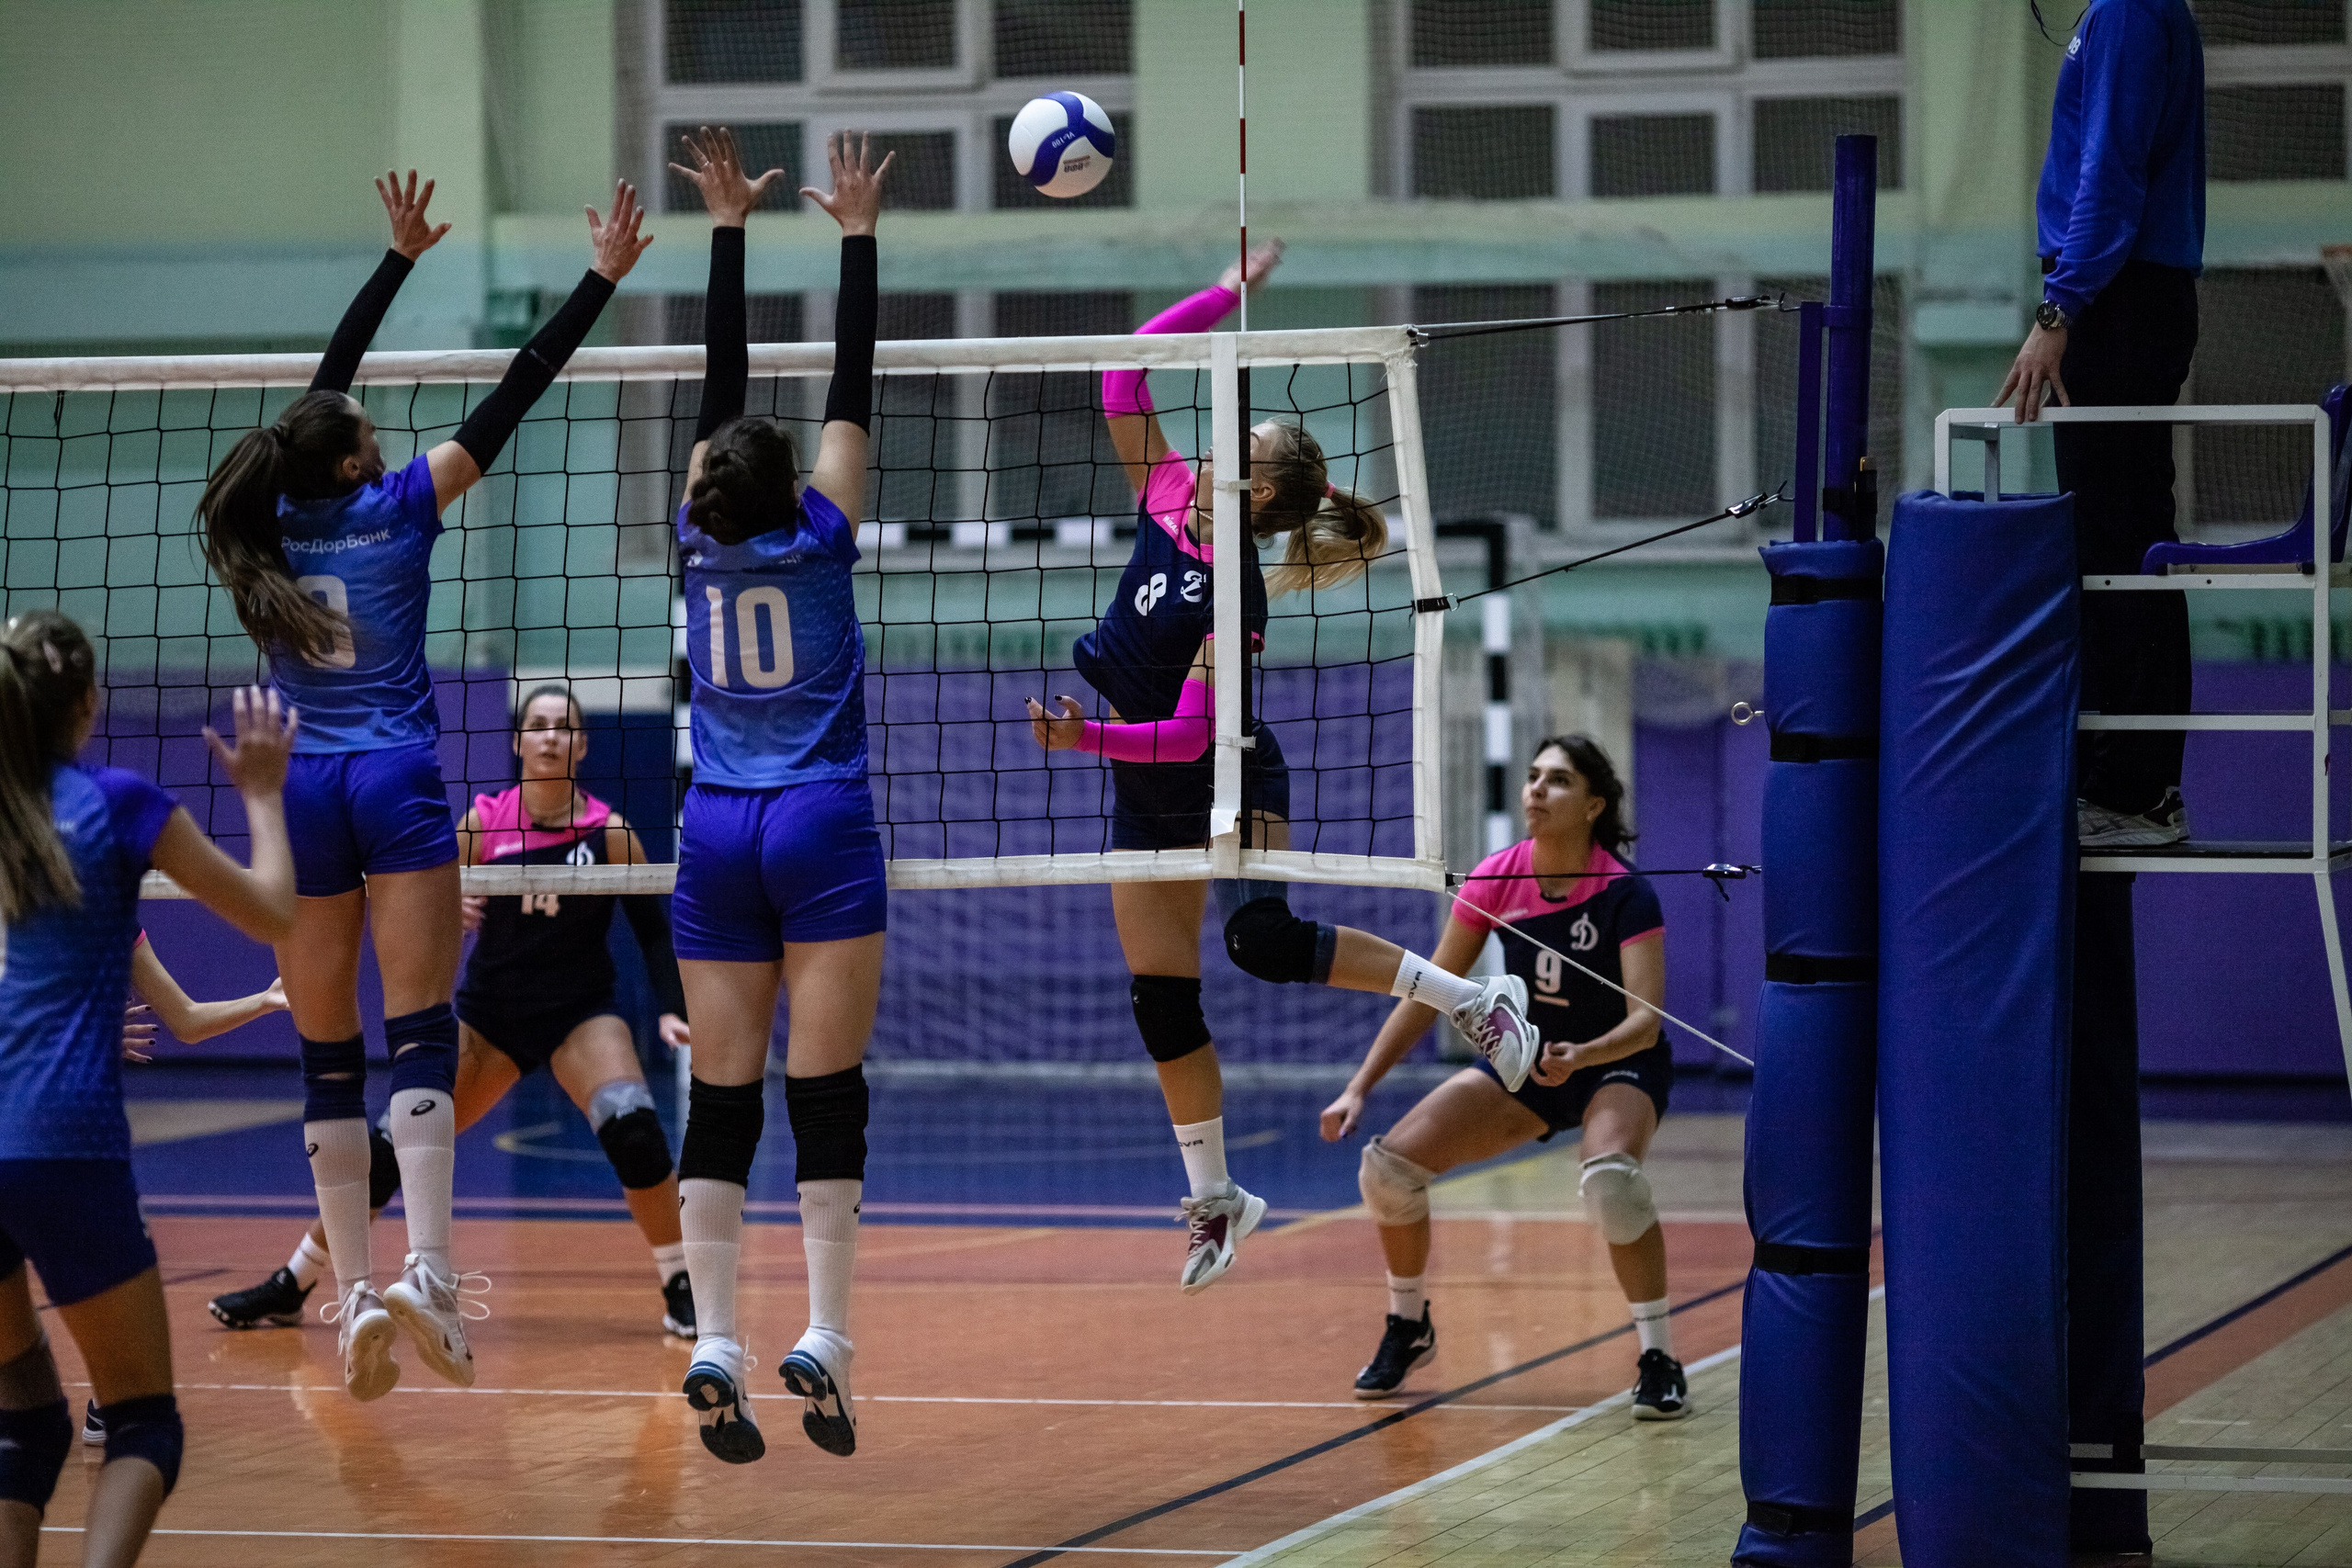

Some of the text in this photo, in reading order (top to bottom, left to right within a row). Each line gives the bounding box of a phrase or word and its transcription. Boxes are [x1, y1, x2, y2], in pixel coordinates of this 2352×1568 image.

[281, 528, 390, 554] РосДорБанк
[1134, 572, 1168, 616] 8
[706, 585, 795, 688] 10
[1534, 949, 1562, 994] 9
